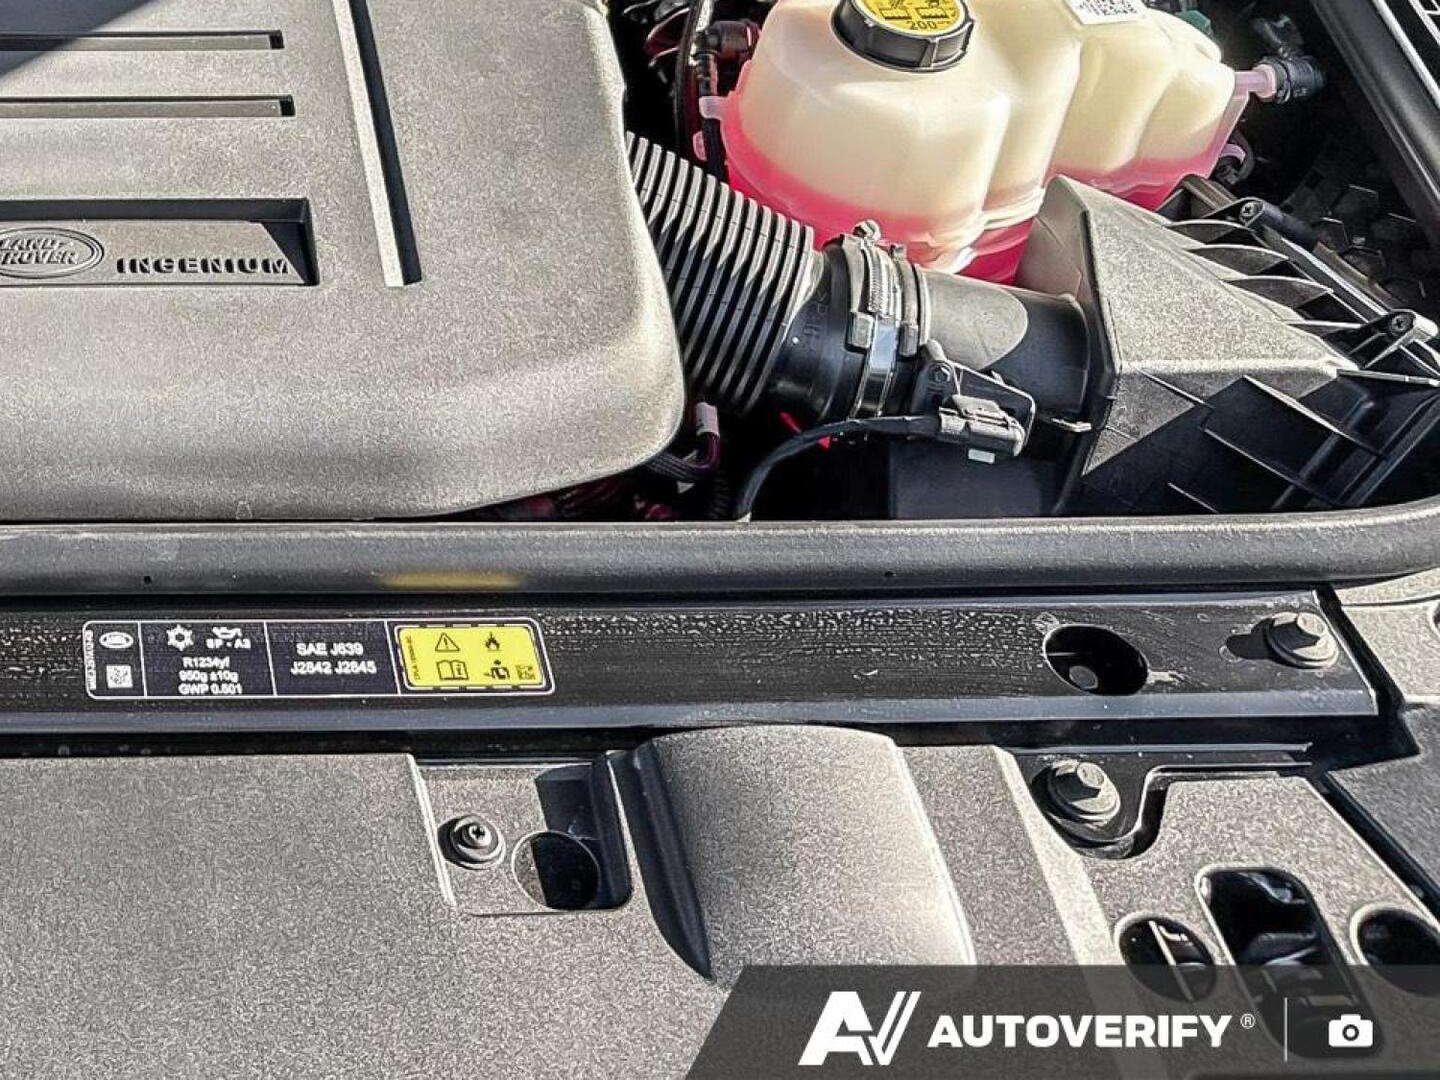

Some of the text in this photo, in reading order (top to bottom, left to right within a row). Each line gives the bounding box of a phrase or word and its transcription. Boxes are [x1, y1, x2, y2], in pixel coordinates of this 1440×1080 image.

[1, 251, 78, 264] ROVER
[116, 257, 289, 274] INGENIUM
[296, 643, 327, 655] SAE
[182, 657, 230, 669] R1234yf
[178, 683, 209, 695] GWP
